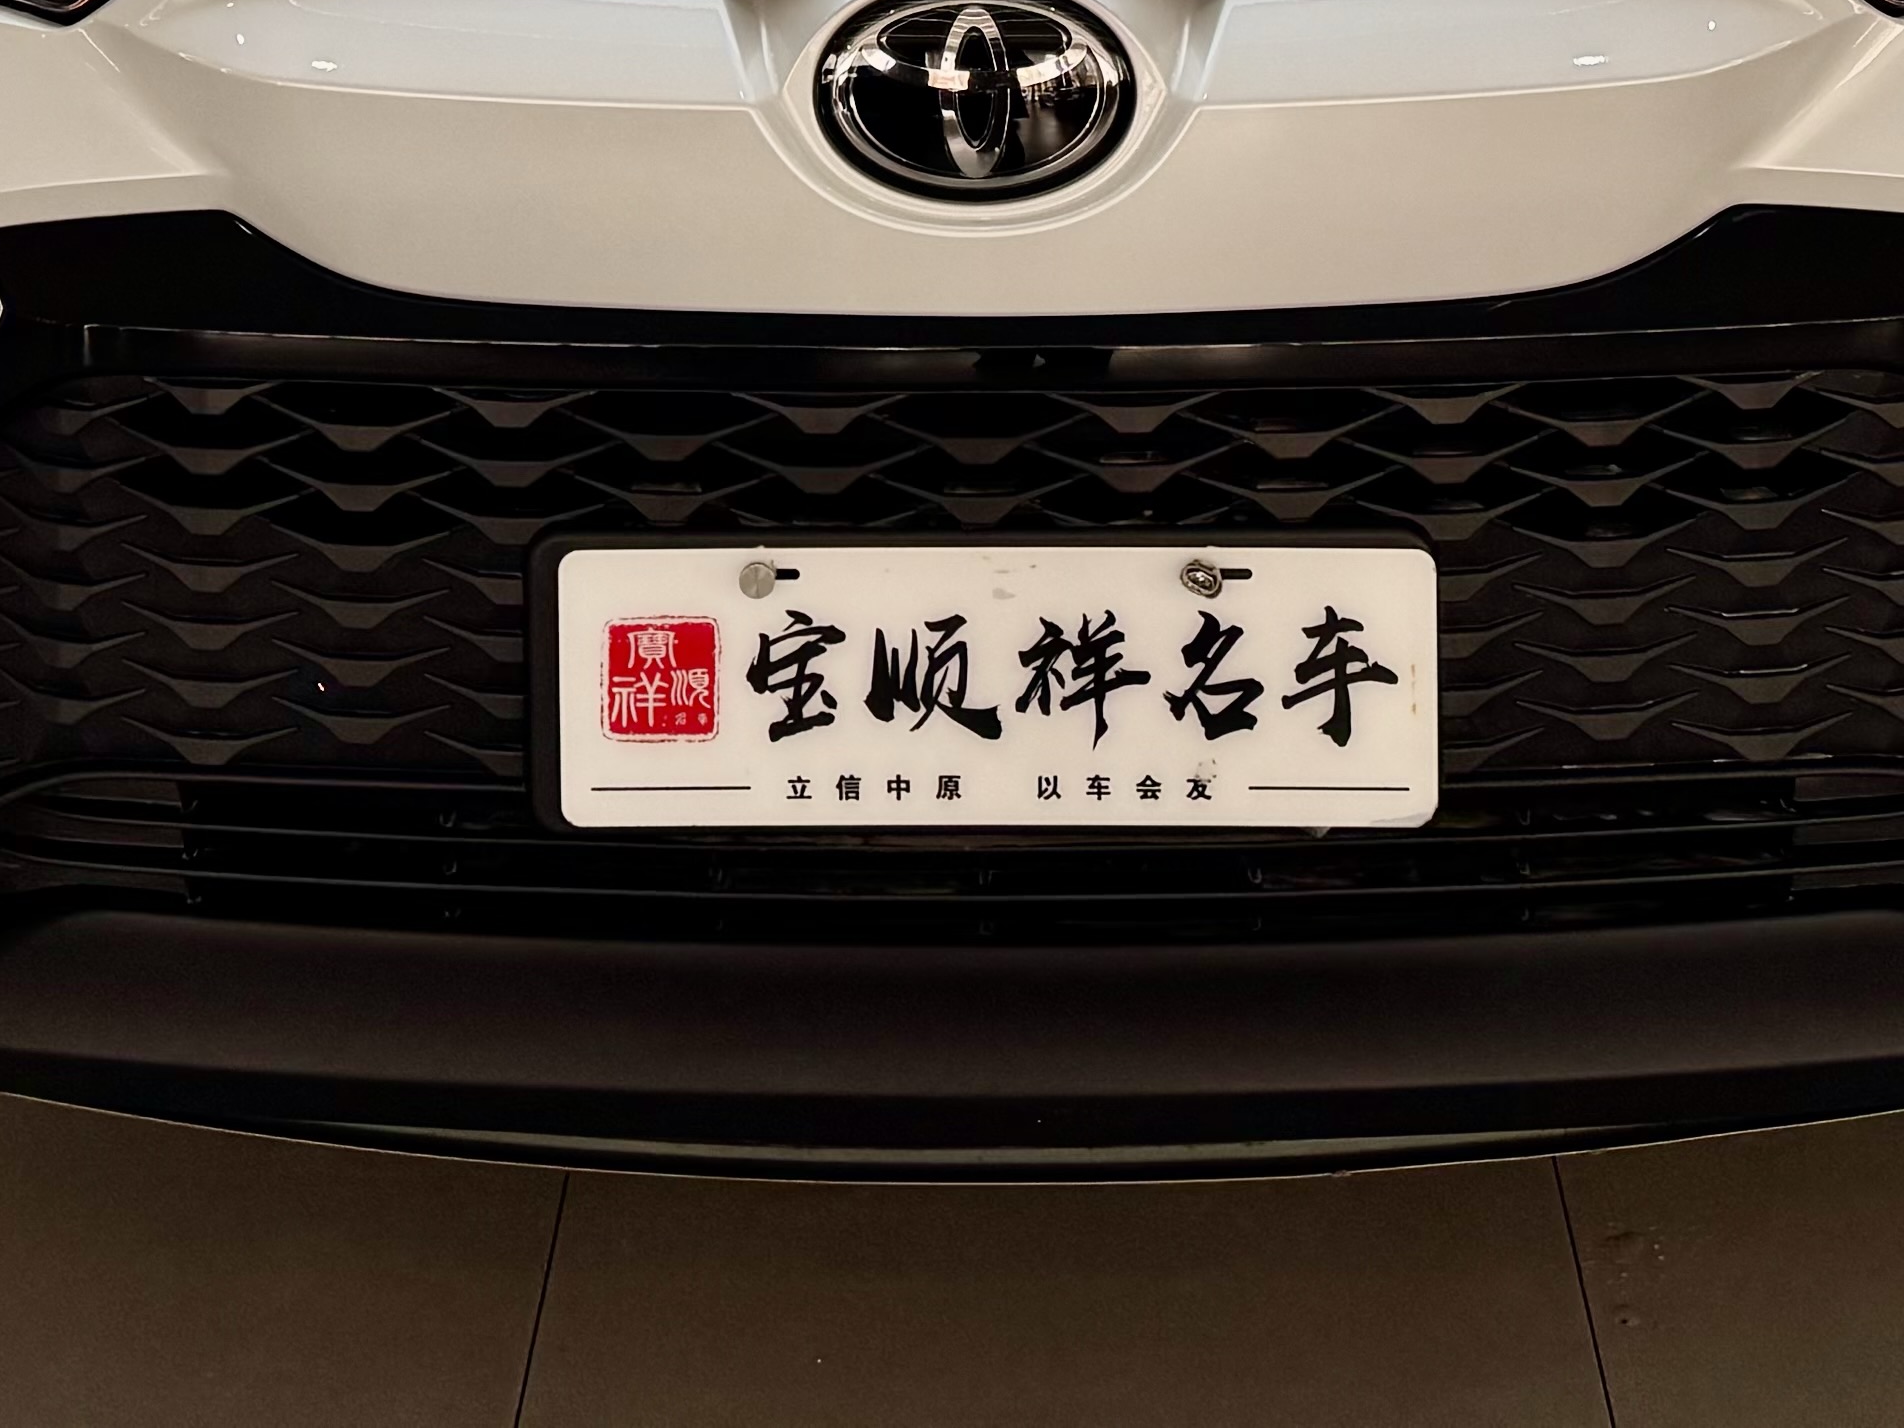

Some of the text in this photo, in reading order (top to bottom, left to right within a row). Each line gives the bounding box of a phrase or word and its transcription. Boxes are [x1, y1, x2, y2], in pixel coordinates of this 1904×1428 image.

[746, 606, 1399, 750] 宝顺祥名车
[786, 774, 1213, 801] 立信中原 以车会友
